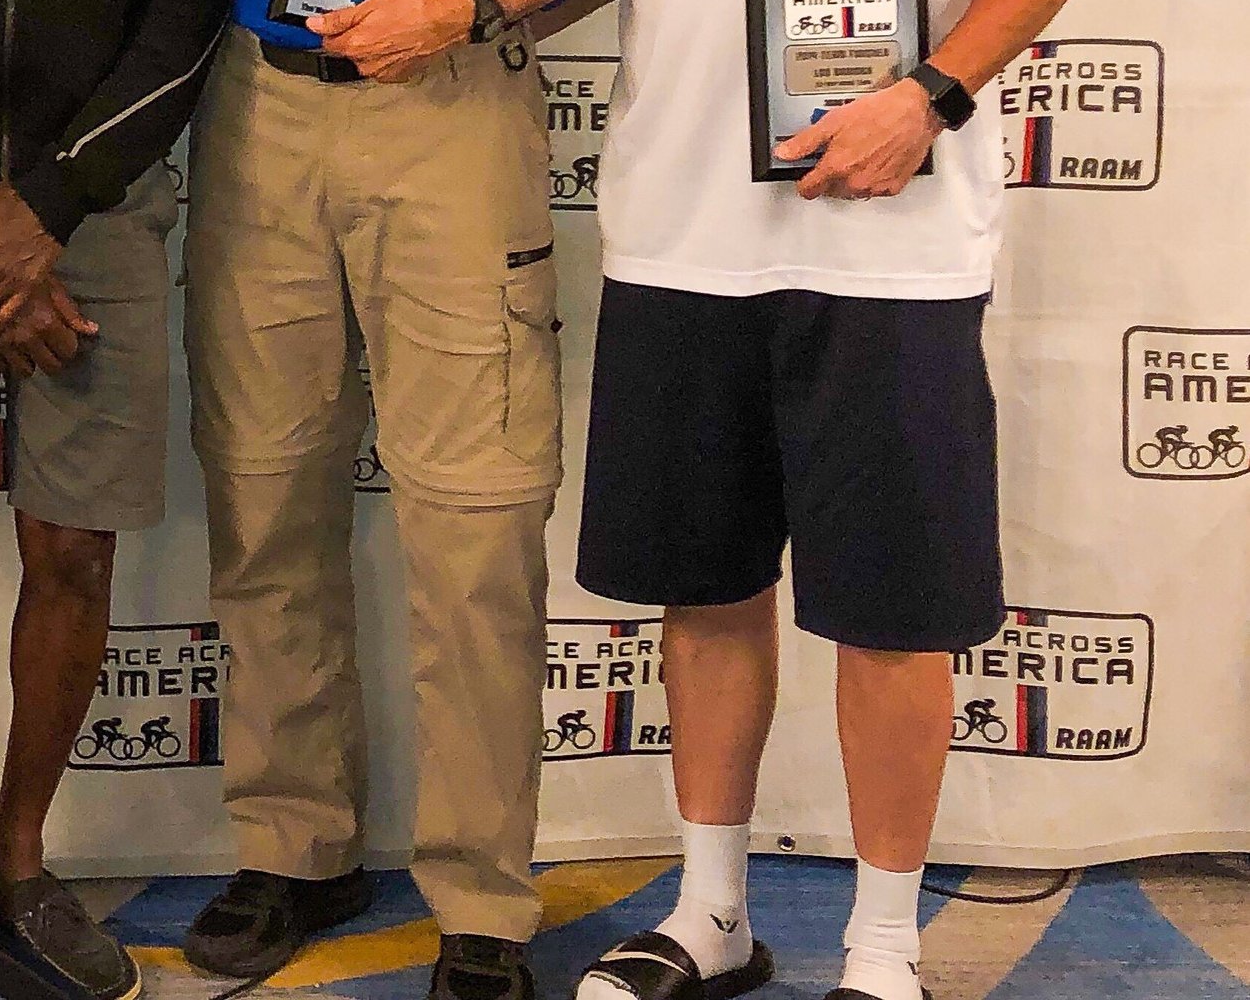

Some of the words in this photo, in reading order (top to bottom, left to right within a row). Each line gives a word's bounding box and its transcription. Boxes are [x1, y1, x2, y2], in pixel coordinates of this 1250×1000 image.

[1019, 62, 1141, 86] ACROSS
[1001, 84, 1141, 114] ERICA
[1060, 157, 1142, 180] RAAM
[1144, 350, 1229, 370] RACE
[597, 639, 664, 662] ACR
[1001, 630, 1133, 655] ACROSS
[104, 647, 161, 666] ACE
[178, 645, 231, 663] ACR
[952, 653, 1133, 688] MERICA
[96, 666, 220, 700] AMER
[639, 725, 673, 744] RA
[1056, 727, 1132, 750] RAAM
